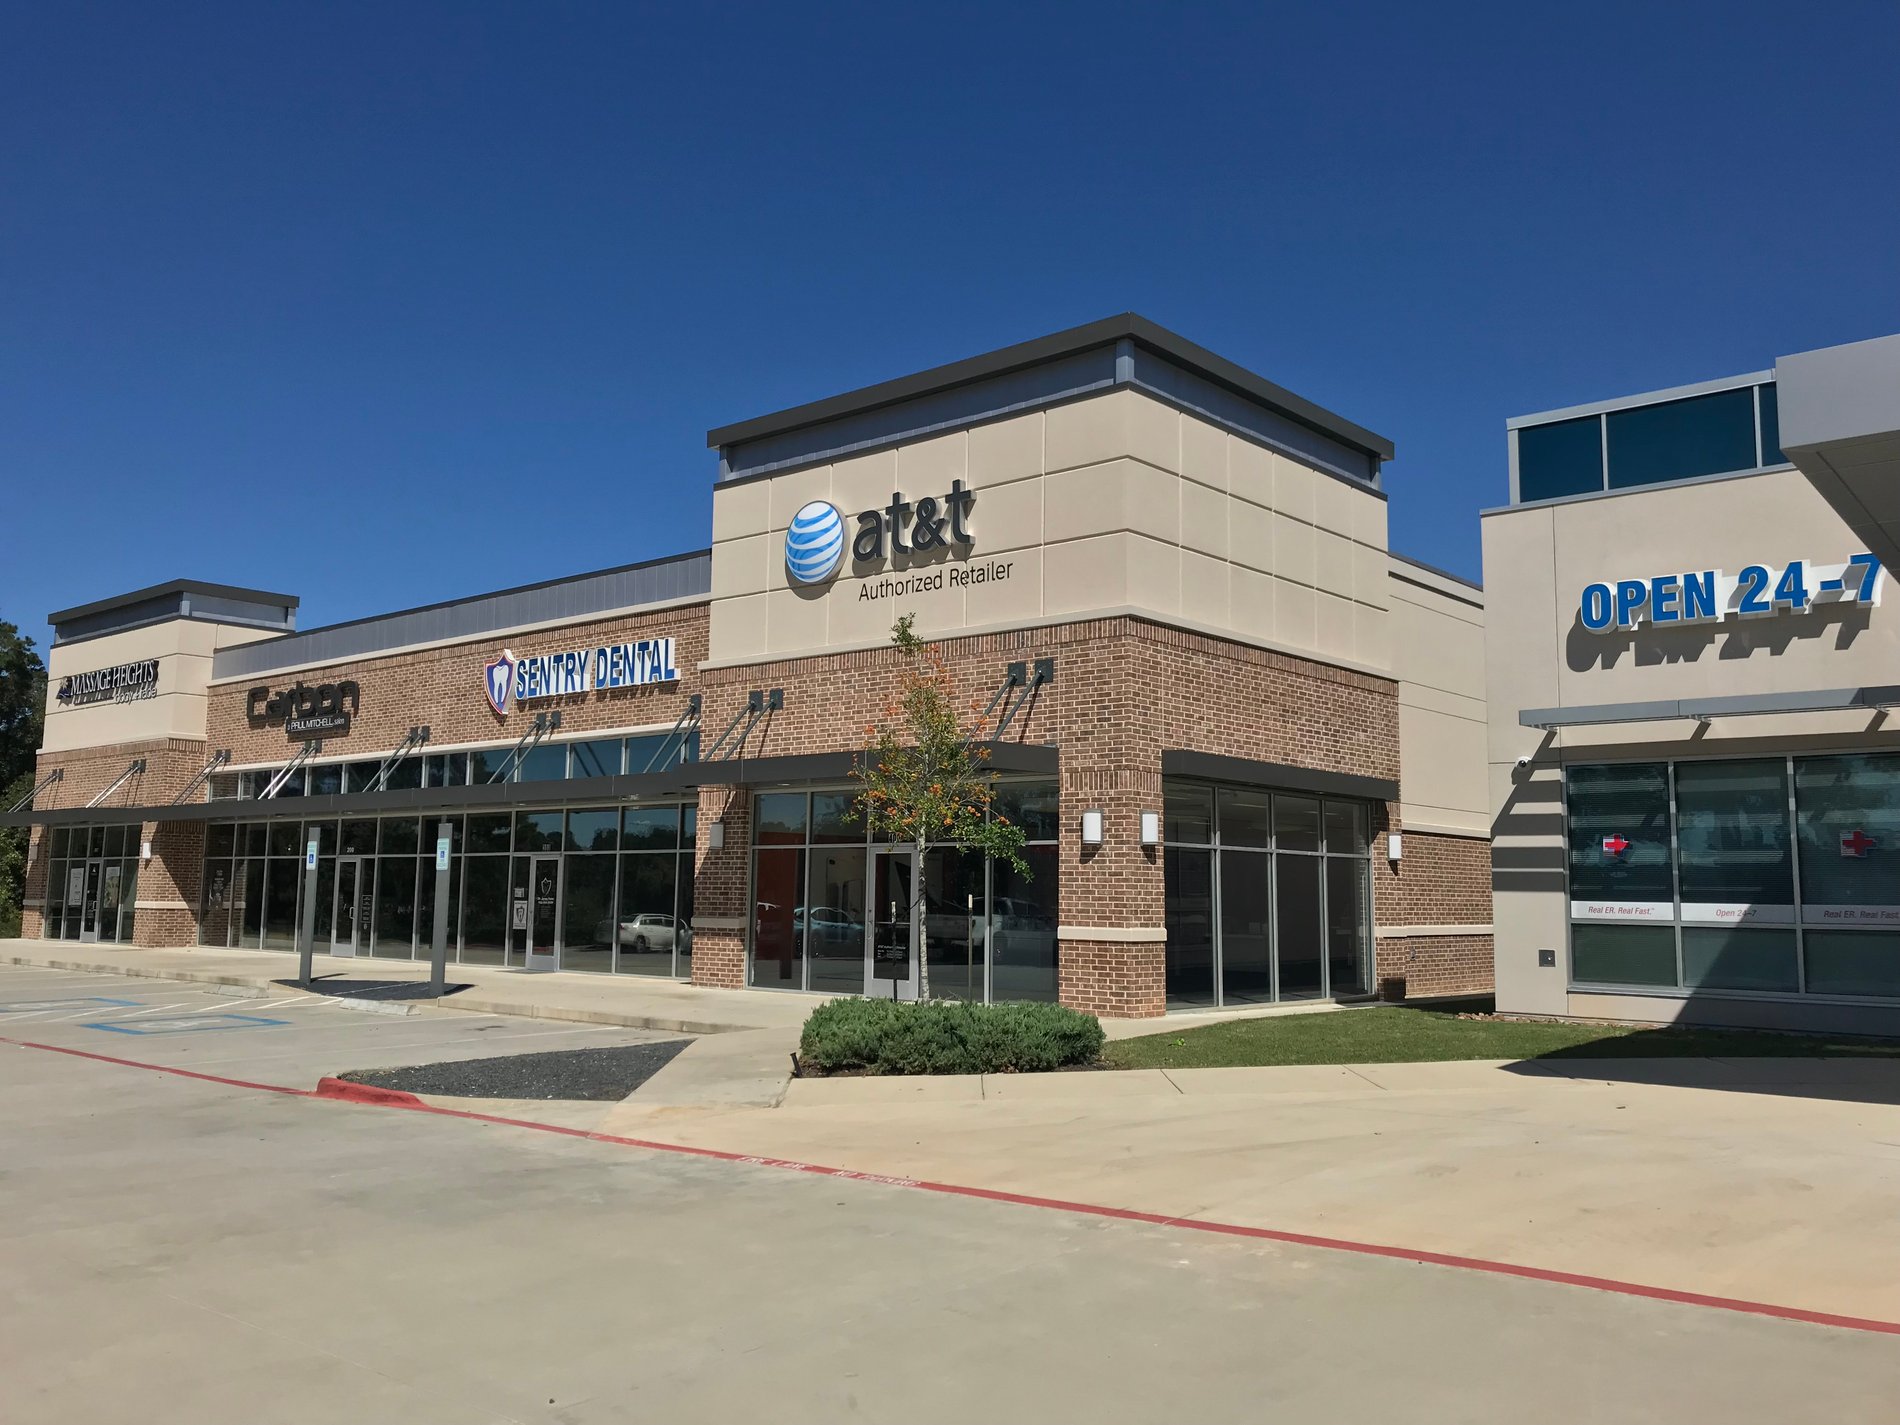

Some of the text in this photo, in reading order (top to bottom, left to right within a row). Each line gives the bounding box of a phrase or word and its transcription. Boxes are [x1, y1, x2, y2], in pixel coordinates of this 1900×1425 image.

[853, 479, 973, 562] at&t
[859, 562, 1014, 602] Authorized Retailer
[1580, 553, 1883, 631] OPEN 24-7
[70, 660, 155, 696] MASSAGE HEIGHTS
[516, 638, 676, 700] SENTRY DENTAL
[247, 681, 360, 721] Carbon
[306, 717, 333, 729] MITCHELL
[1588, 906, 1603, 914] Real
[1604, 906, 1616, 914] ER.
[1618, 907, 1633, 915] Real
[1716, 909, 1735, 918] Open
[1824, 910, 1842, 919] Real
[1860, 910, 1878, 919] Real
